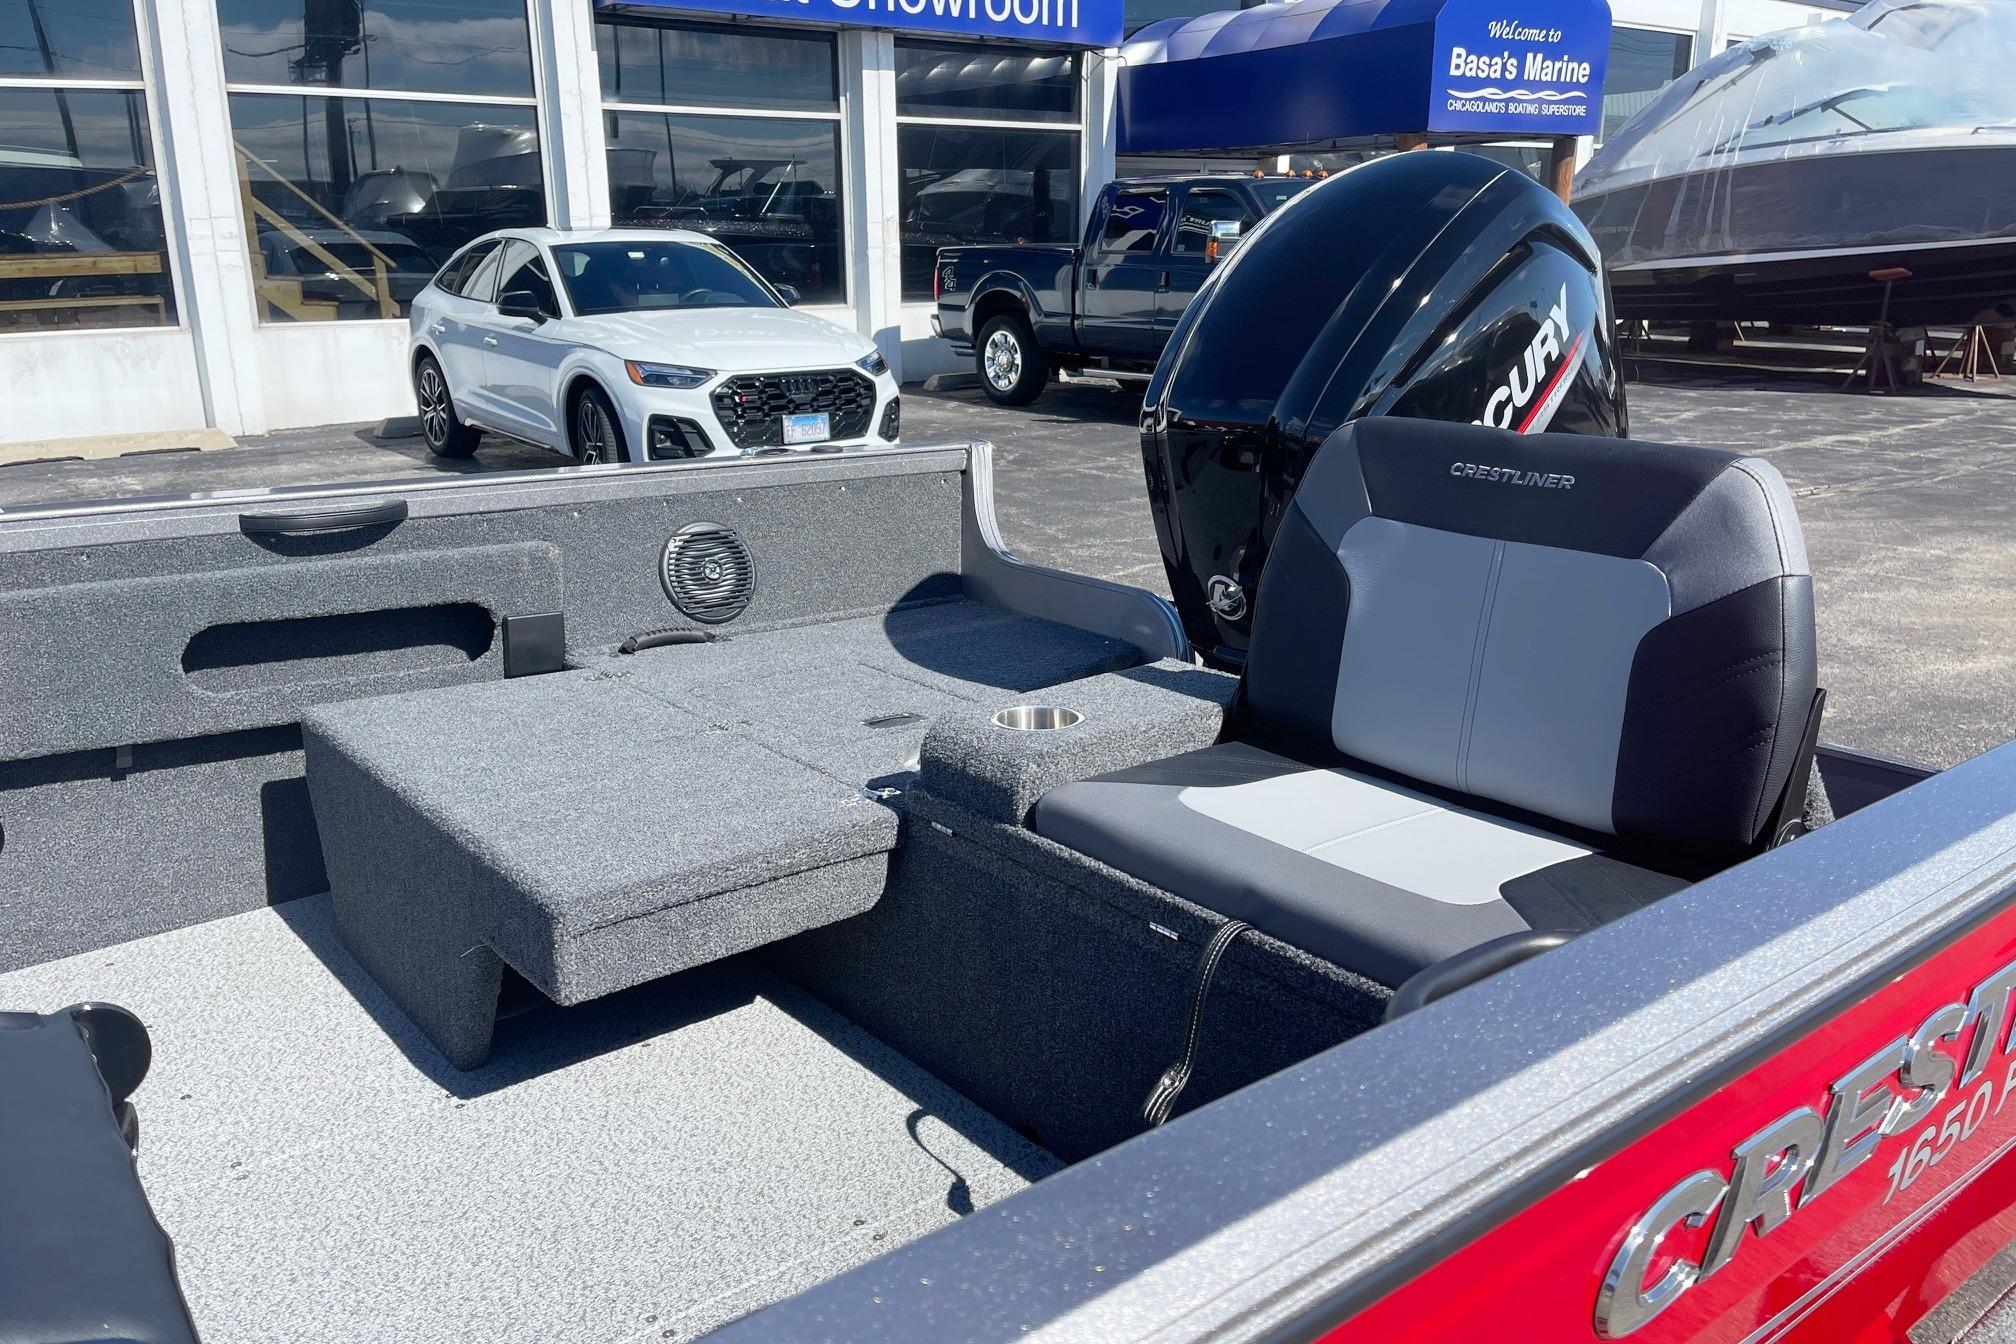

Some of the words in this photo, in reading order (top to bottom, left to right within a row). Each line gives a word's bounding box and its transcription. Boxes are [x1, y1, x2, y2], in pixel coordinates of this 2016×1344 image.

[831, 0, 1078, 28] owroom
[1488, 19, 1547, 42] Welcome
[1548, 29, 1562, 43] to
[1449, 47, 1518, 80] Basa's
[1524, 53, 1590, 83] Marine
[1447, 99, 1506, 114] CHICAGOLAND'S
[1508, 103, 1539, 115] BOATING
[1541, 105, 1587, 116] SUPERSTORE
[1471, 281, 1569, 429] CURY
[1450, 462, 1575, 490] CRESTLINER
[1593, 959, 2016, 1339] CREST
[1882, 1080, 1992, 1206] 1650
